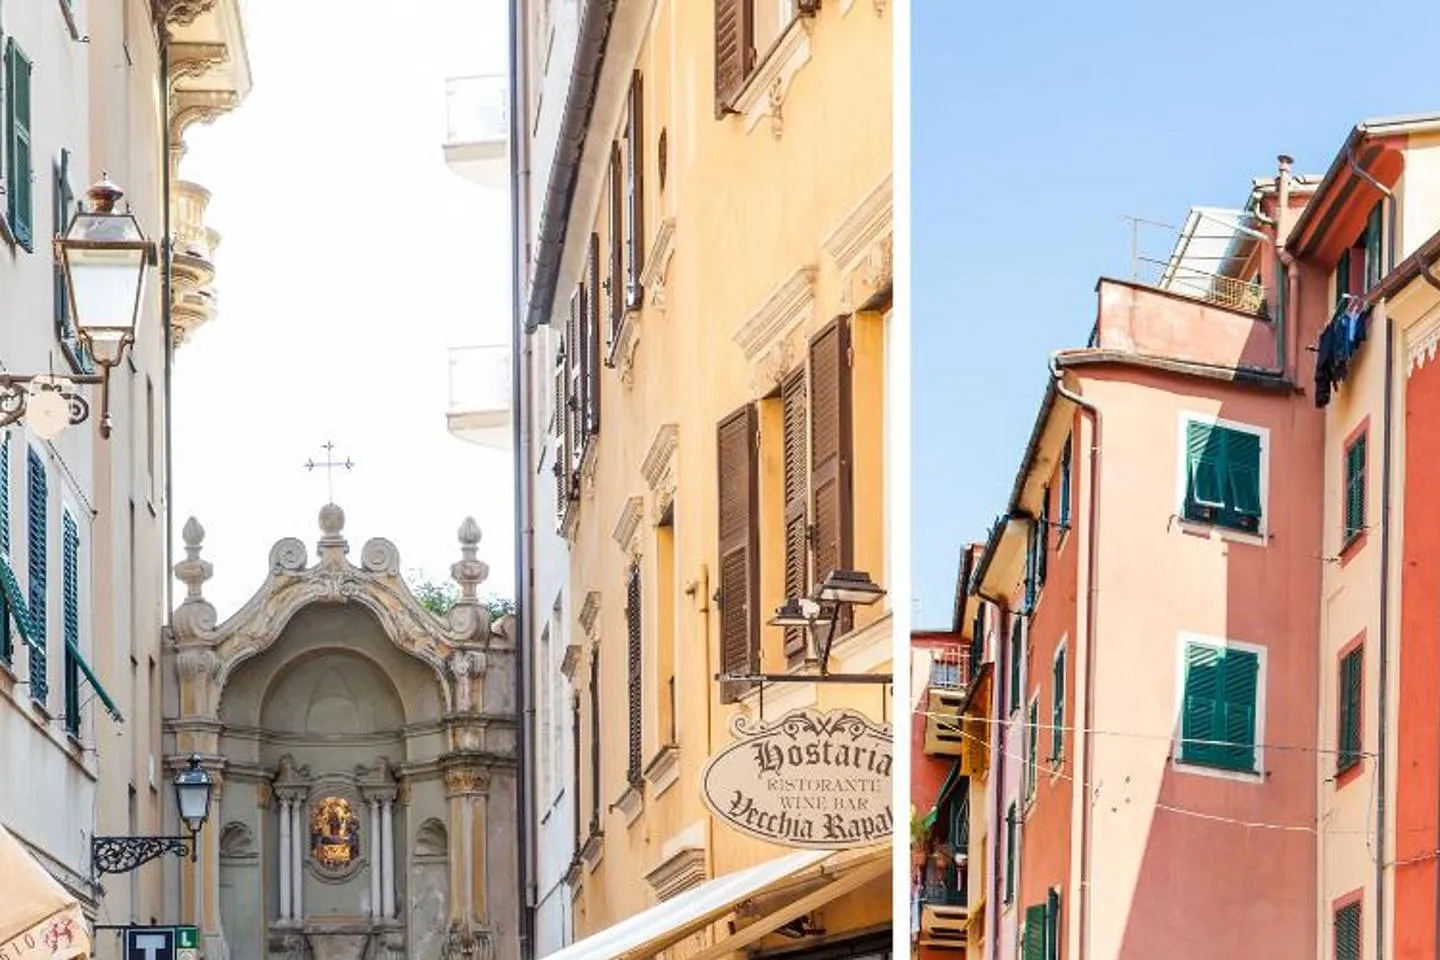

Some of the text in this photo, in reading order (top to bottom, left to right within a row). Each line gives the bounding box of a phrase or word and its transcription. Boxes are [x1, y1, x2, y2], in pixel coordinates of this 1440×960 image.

[750, 739, 893, 778] Hostaria
[766, 778, 881, 793] RISTORANTE
[728, 790, 814, 839] Vecchia
[780, 797, 869, 811] WINE BAR
